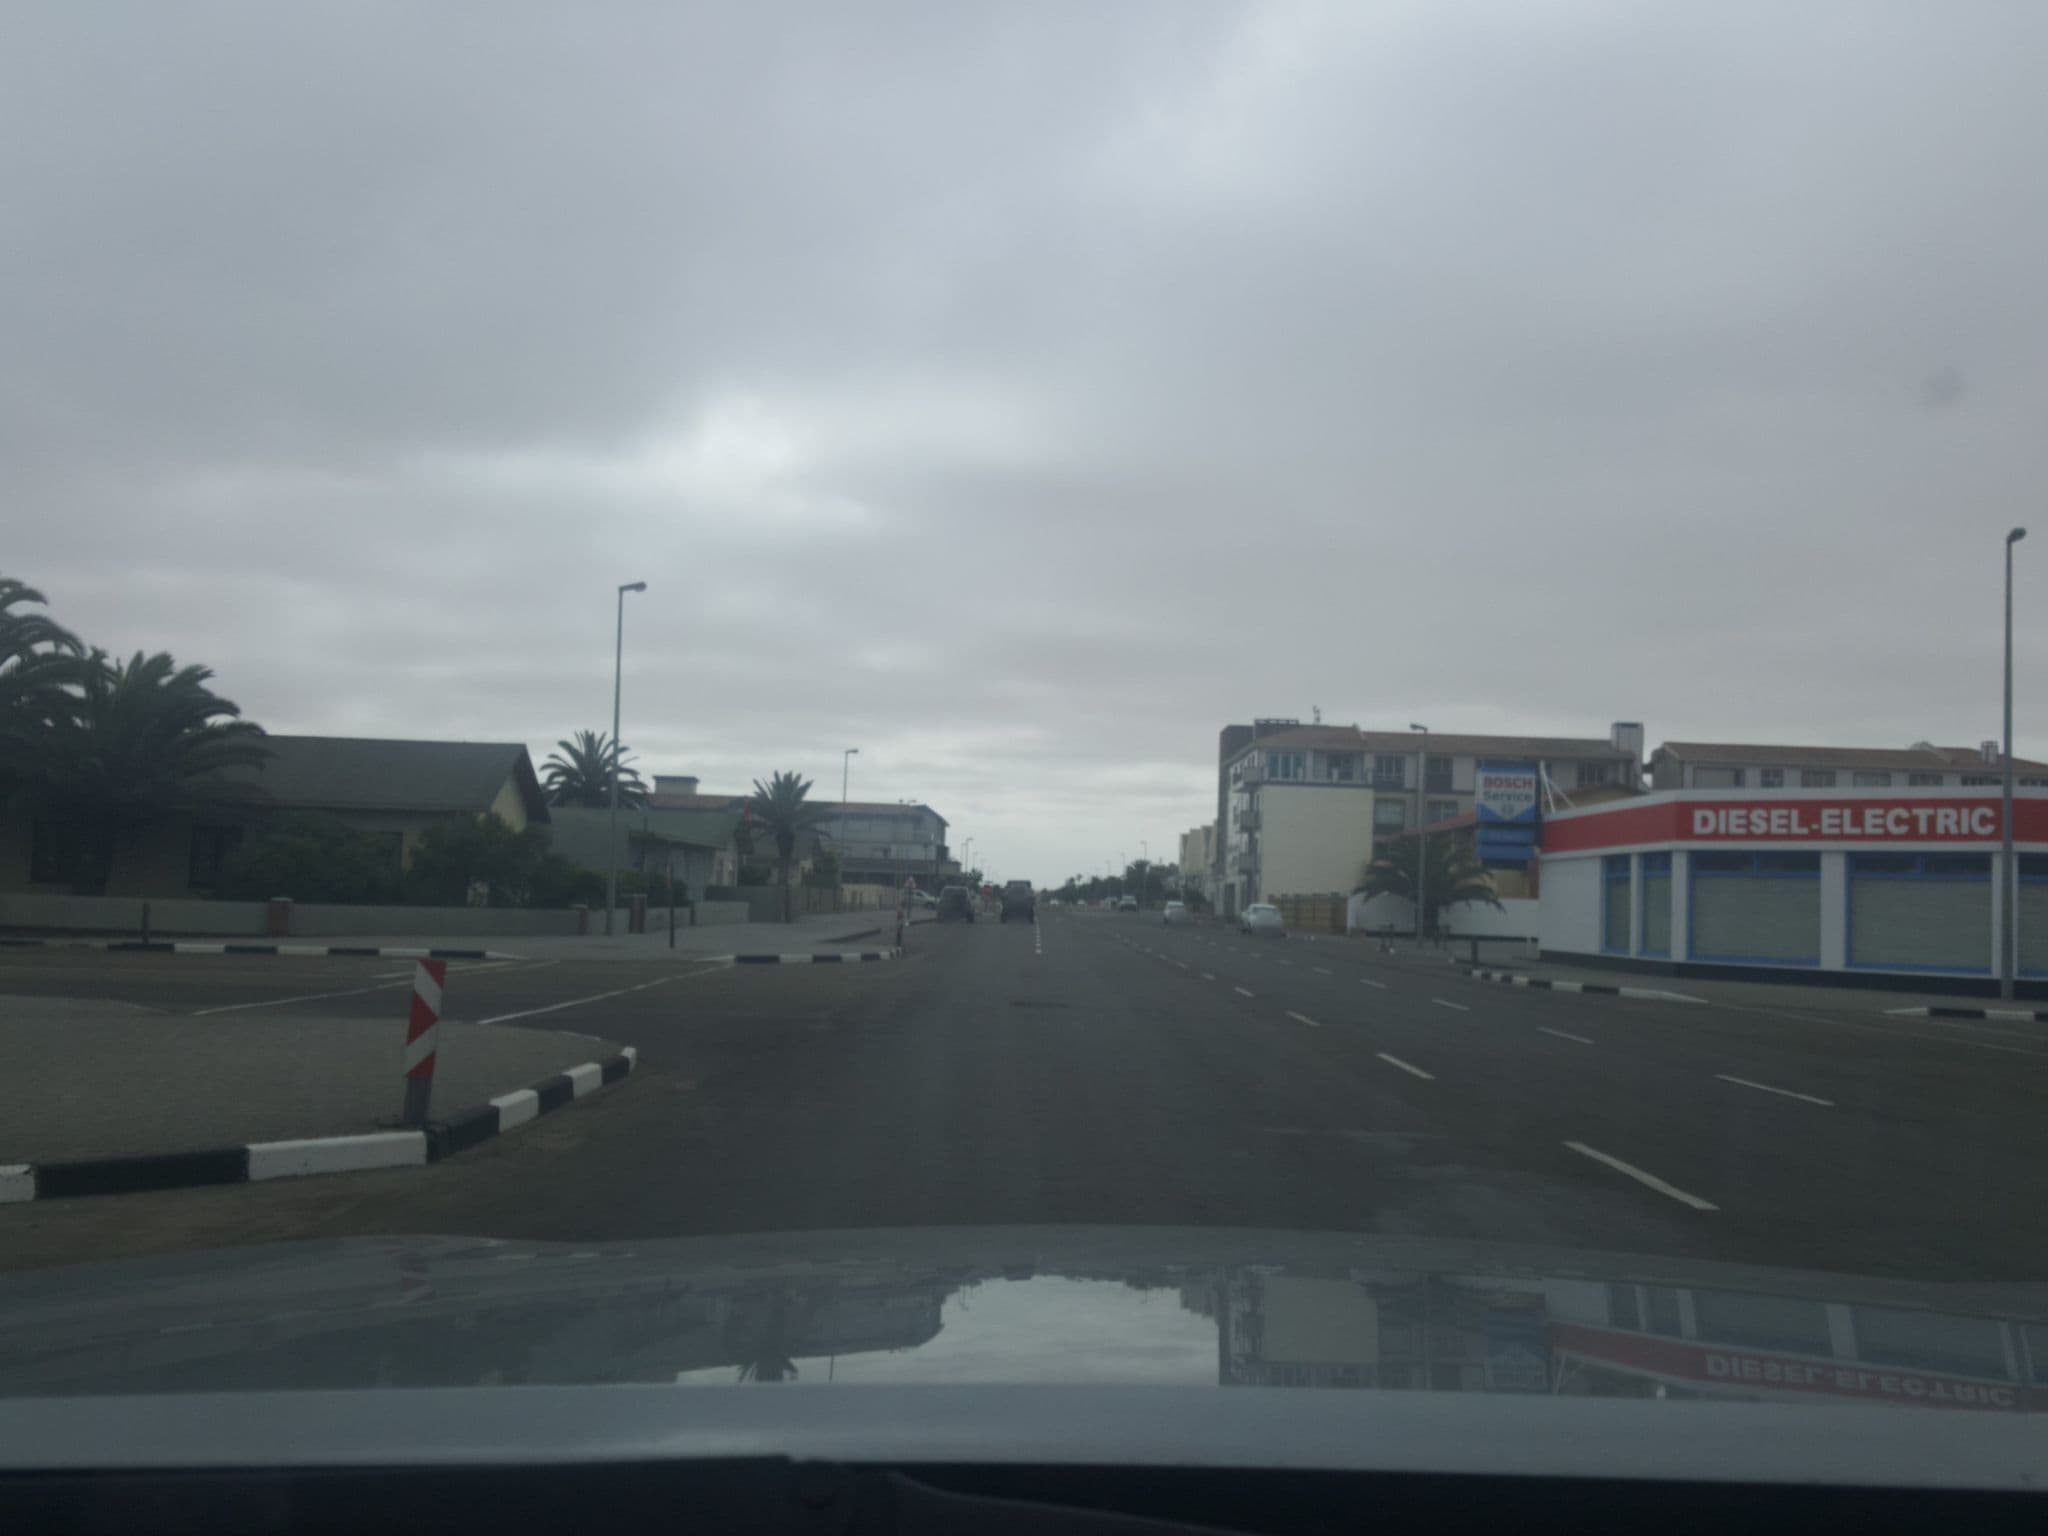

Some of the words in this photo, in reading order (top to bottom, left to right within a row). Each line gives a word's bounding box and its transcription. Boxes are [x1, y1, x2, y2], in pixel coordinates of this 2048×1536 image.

[1484, 776, 1533, 789] BOSCH
[1484, 791, 1532, 801] Service
[1693, 807, 1995, 835] DIESEL-ELECTRIC
